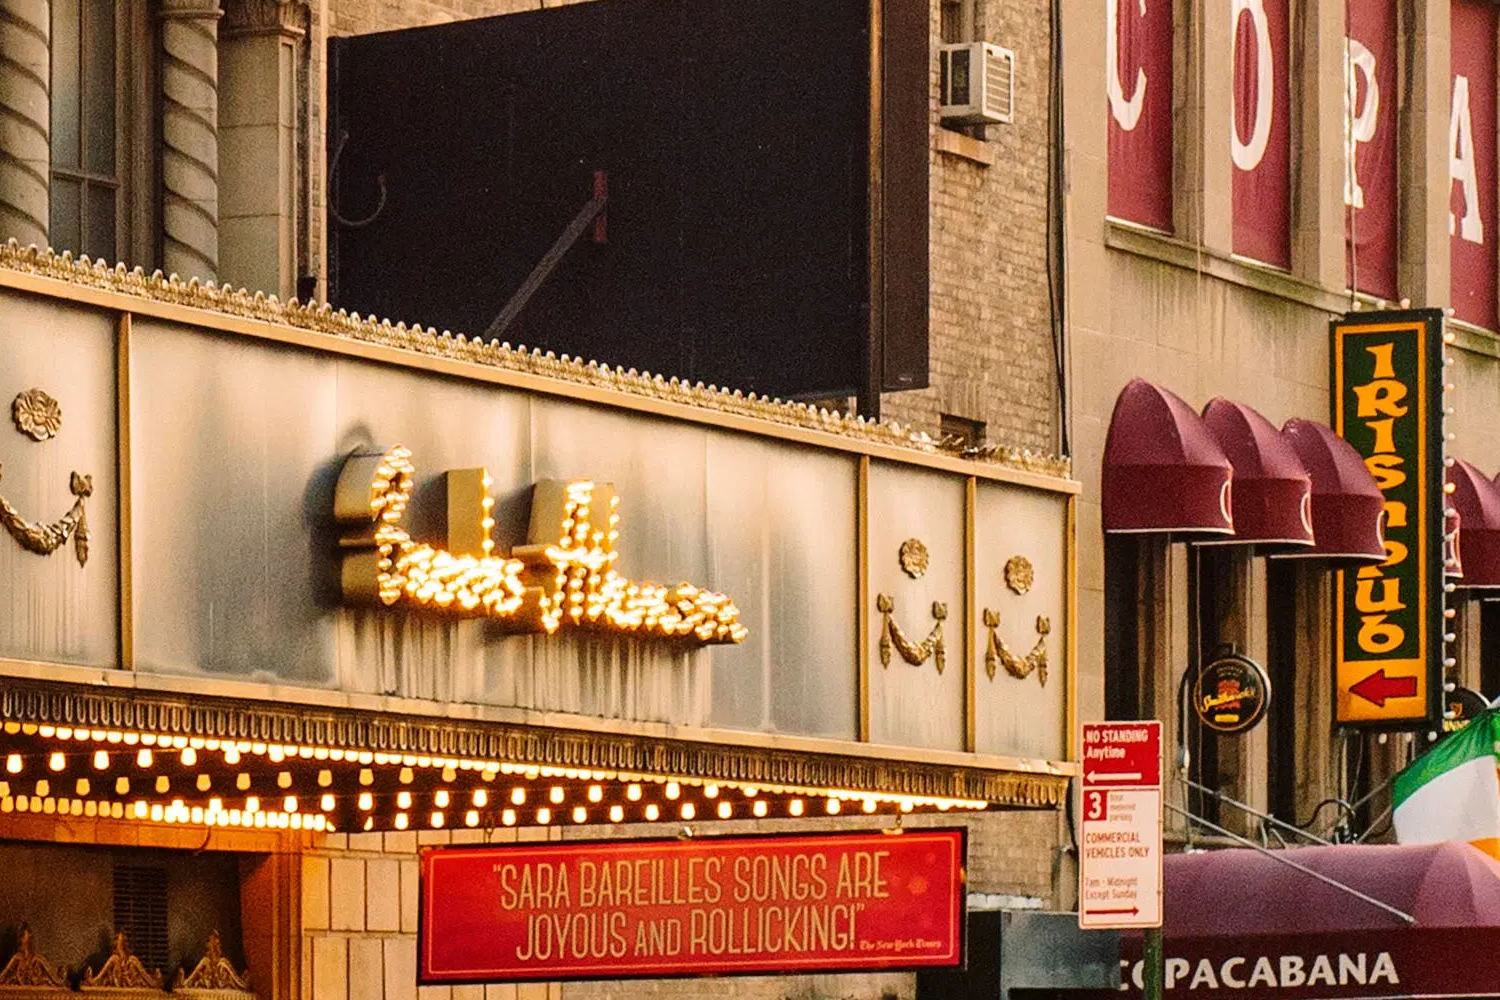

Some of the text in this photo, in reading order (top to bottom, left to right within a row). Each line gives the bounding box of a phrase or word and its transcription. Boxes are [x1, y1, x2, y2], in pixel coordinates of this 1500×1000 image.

[1086, 729, 1148, 743] NO STANDING
[1086, 746, 1125, 761] Anytime
[1088, 792, 1102, 819] 3
[1086, 832, 1140, 844] COMMERCIAL
[1086, 846, 1149, 859] VEHICLES ONLY
[492, 851, 890, 910] "SARA BAREILLES' SONGS ARE
[515, 911, 627, 961] JOYOUS
[634, 919, 681, 957] AND
